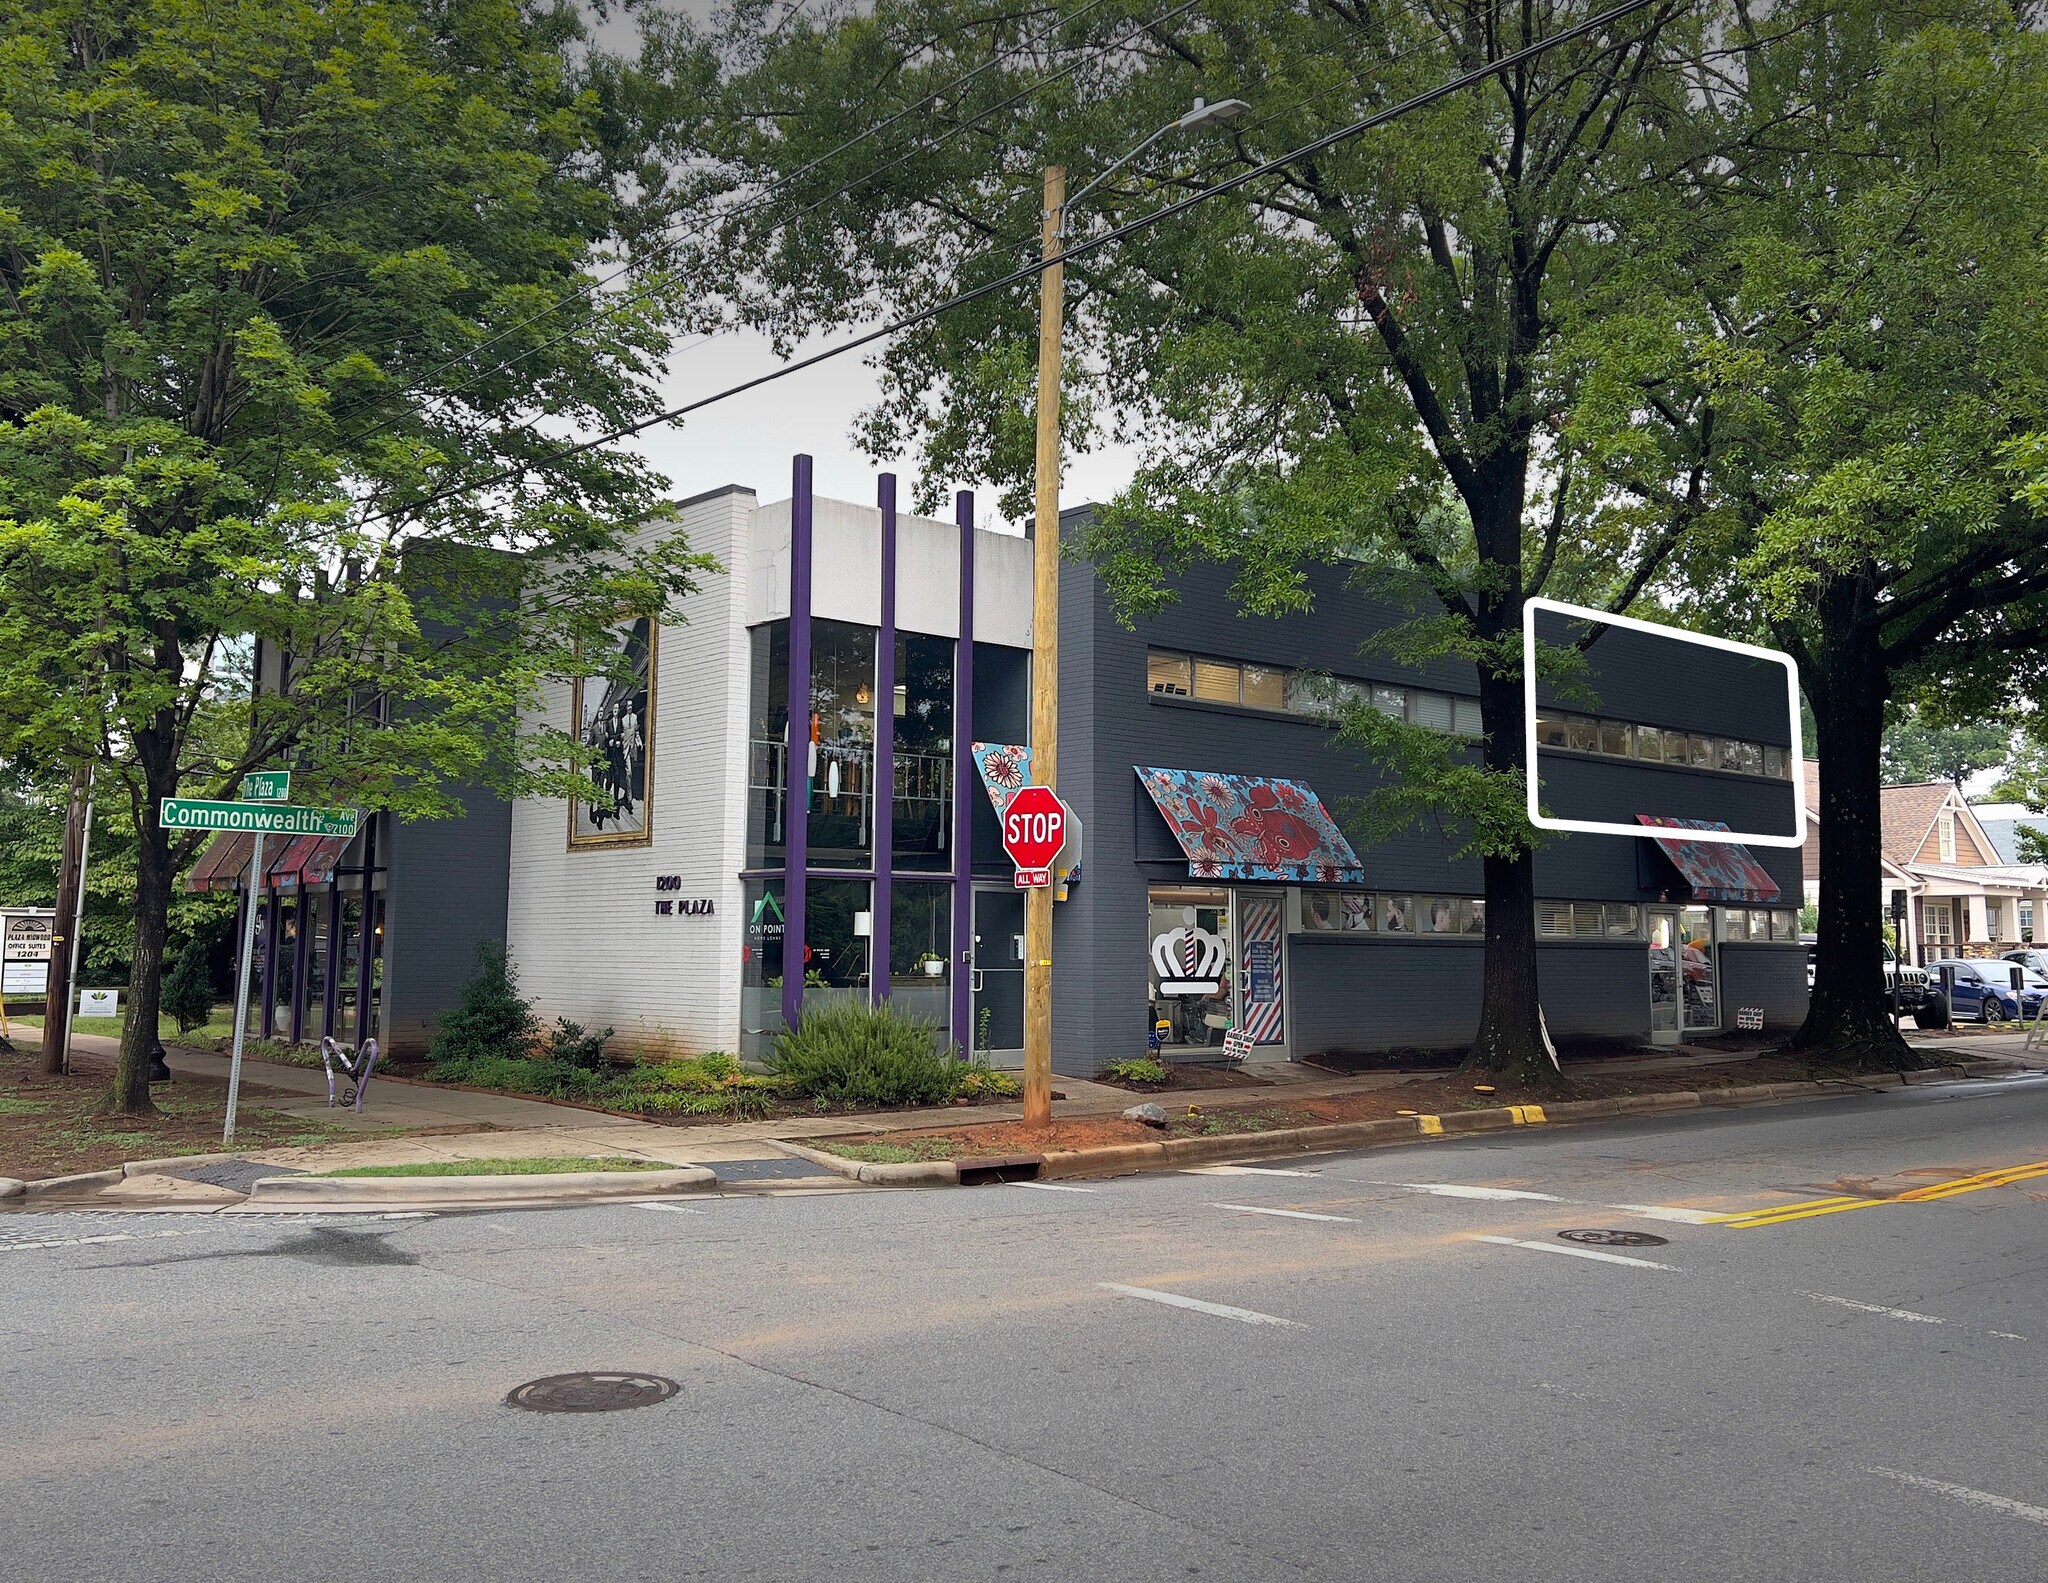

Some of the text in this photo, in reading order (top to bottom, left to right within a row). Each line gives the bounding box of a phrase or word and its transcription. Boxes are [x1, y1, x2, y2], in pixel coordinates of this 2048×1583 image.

[244, 778, 253, 796] The
[254, 777, 273, 796] Plaza
[163, 802, 354, 832] Commonwealth Ave
[333, 824, 354, 835] 2100
[1007, 812, 1062, 844] STOP
[656, 875, 682, 890] 1200
[1017, 873, 1047, 884] ALL WAY
[655, 900, 714, 915] THE PLAZA
[749, 924, 784, 934] ON POINT
